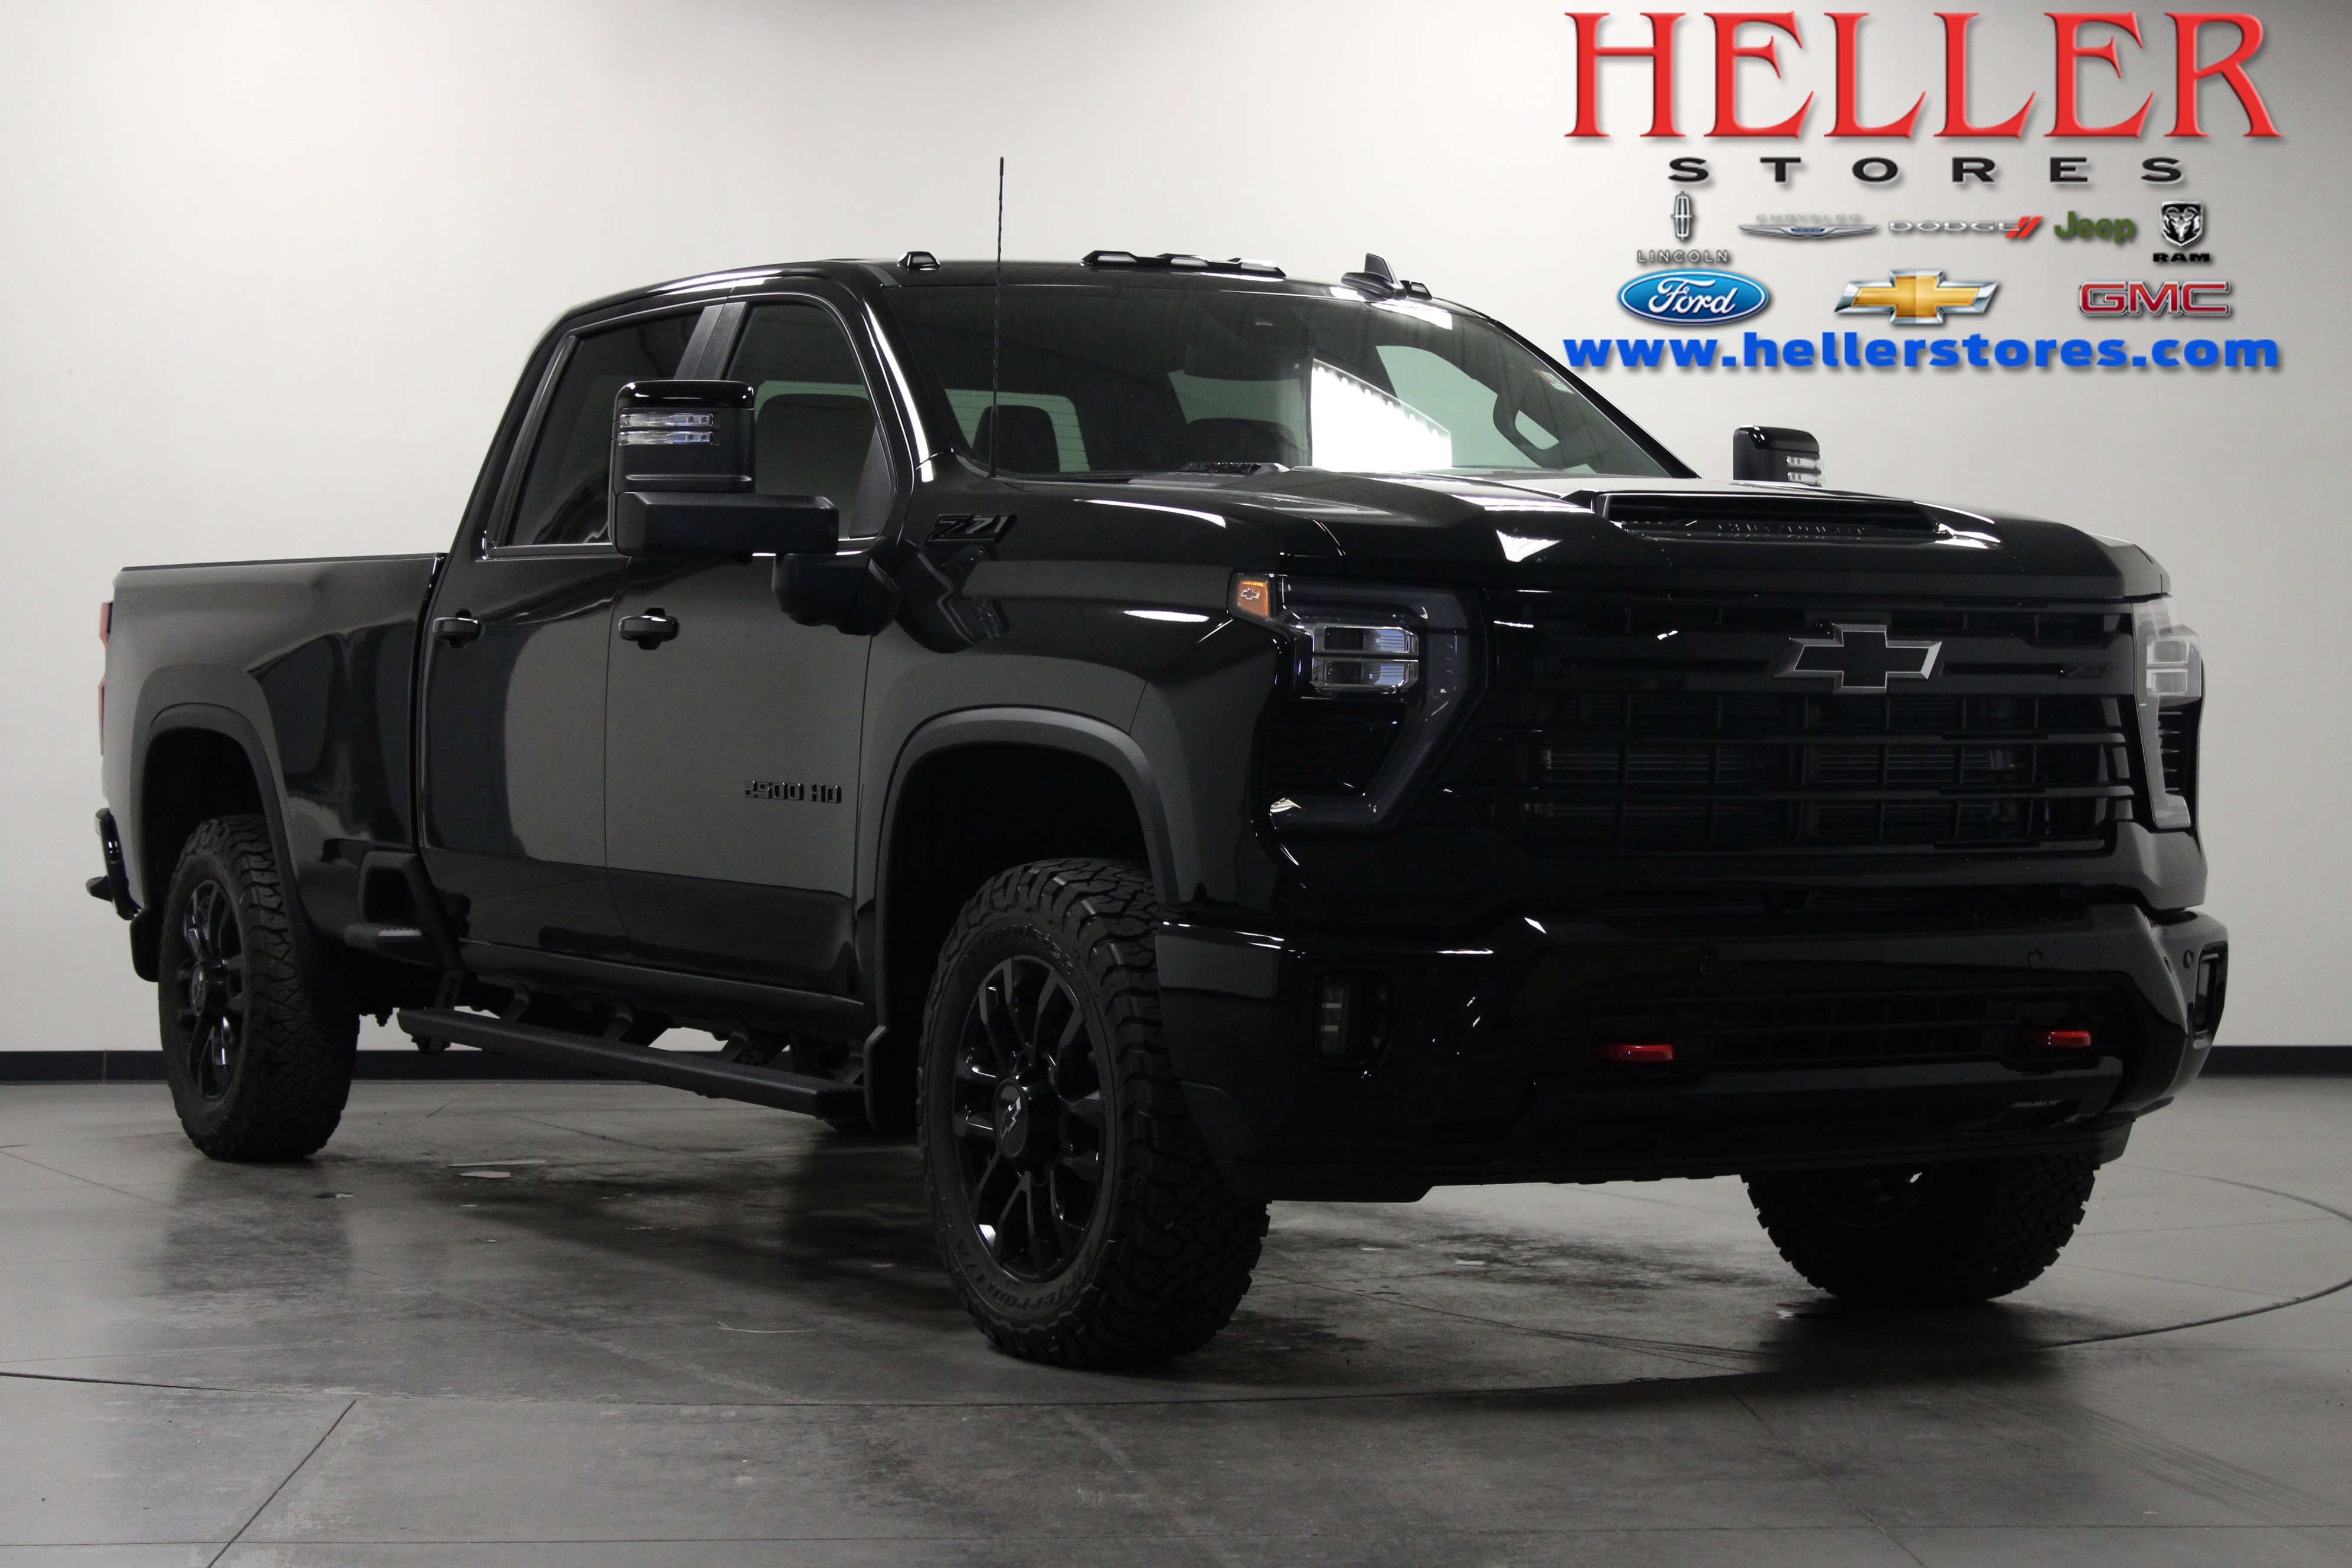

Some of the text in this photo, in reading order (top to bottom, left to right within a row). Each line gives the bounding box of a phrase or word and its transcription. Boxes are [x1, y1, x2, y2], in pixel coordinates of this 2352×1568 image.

[925, 514, 1018, 545] Z71
[744, 780, 842, 804] 2500 HD
